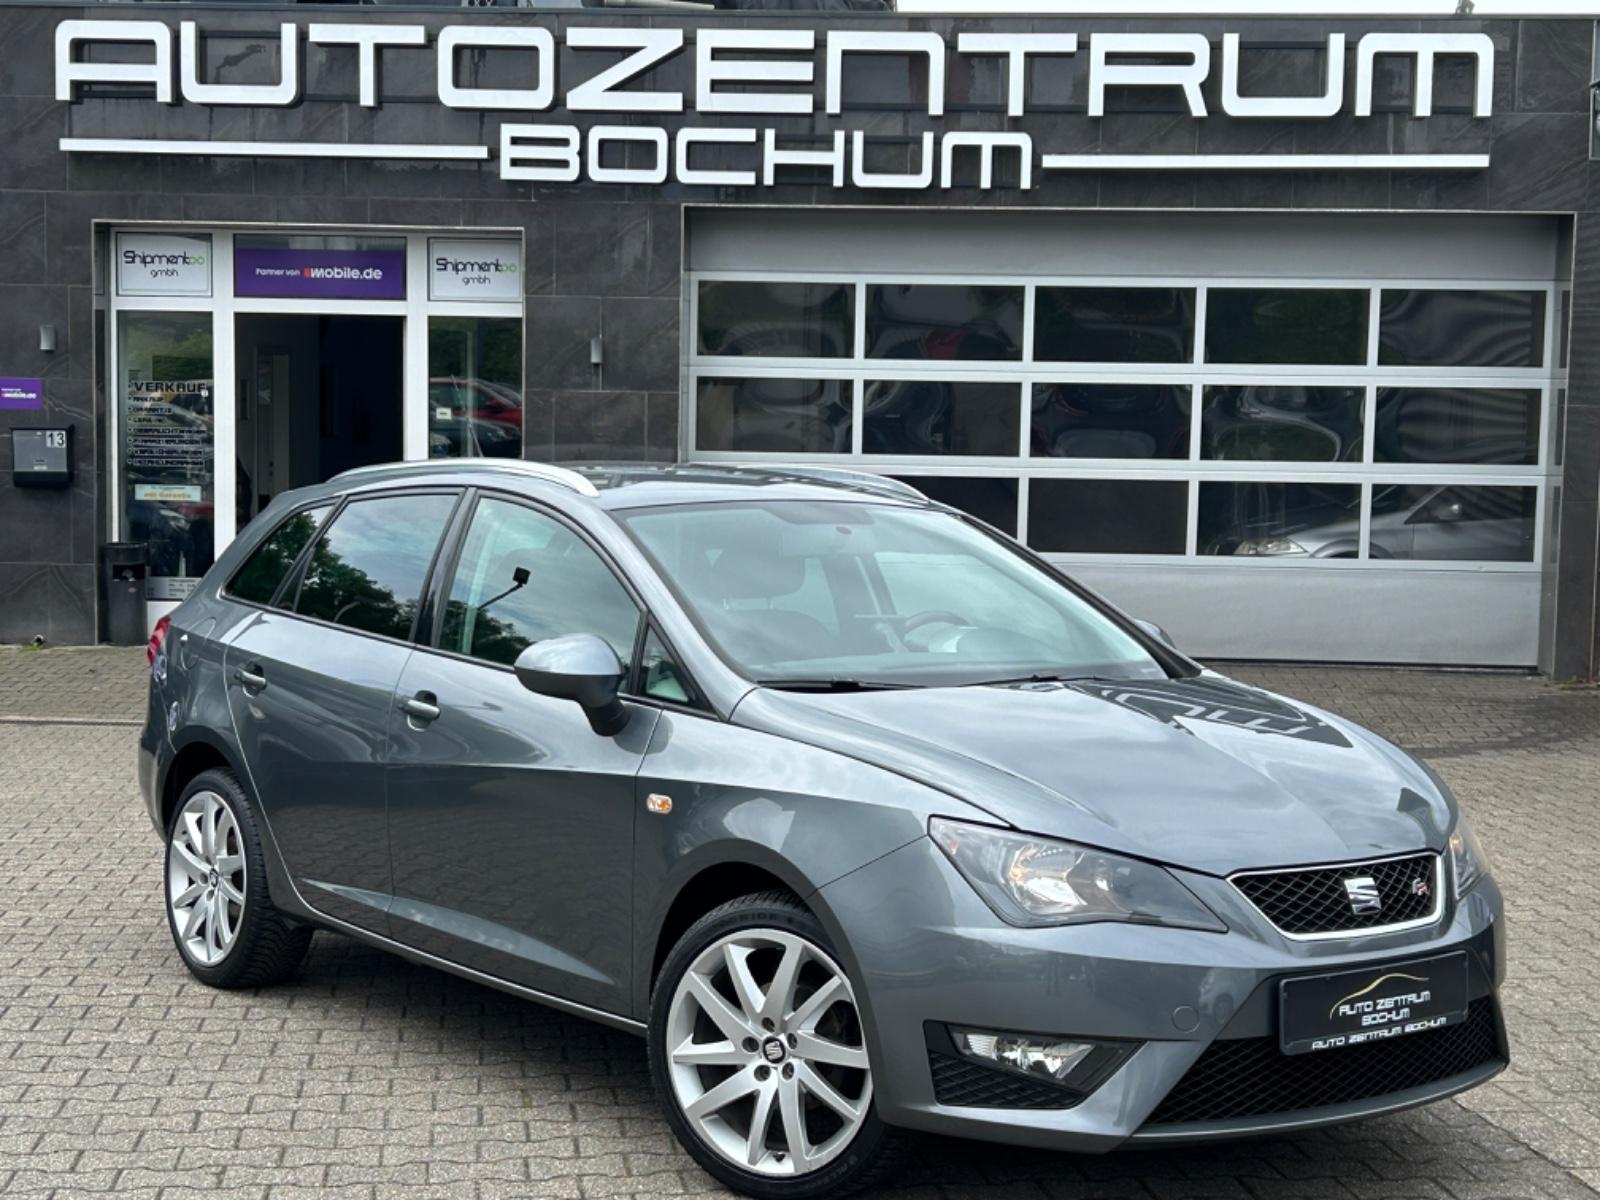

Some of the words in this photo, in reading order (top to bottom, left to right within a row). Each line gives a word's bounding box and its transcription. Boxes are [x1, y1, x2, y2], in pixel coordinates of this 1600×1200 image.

[54, 20, 1495, 118] AUTOZENTRUM
[500, 122, 1034, 190] BOCHUM
[255, 267, 284, 276] Partner
[285, 268, 300, 276] von
[304, 266, 383, 280] mobile.de
[47, 432, 65, 448] 13
[1339, 1001, 1374, 1017] AUTO
[1376, 990, 1431, 1010] ZENTRUM
[1311, 1036, 1346, 1050] AUTO
